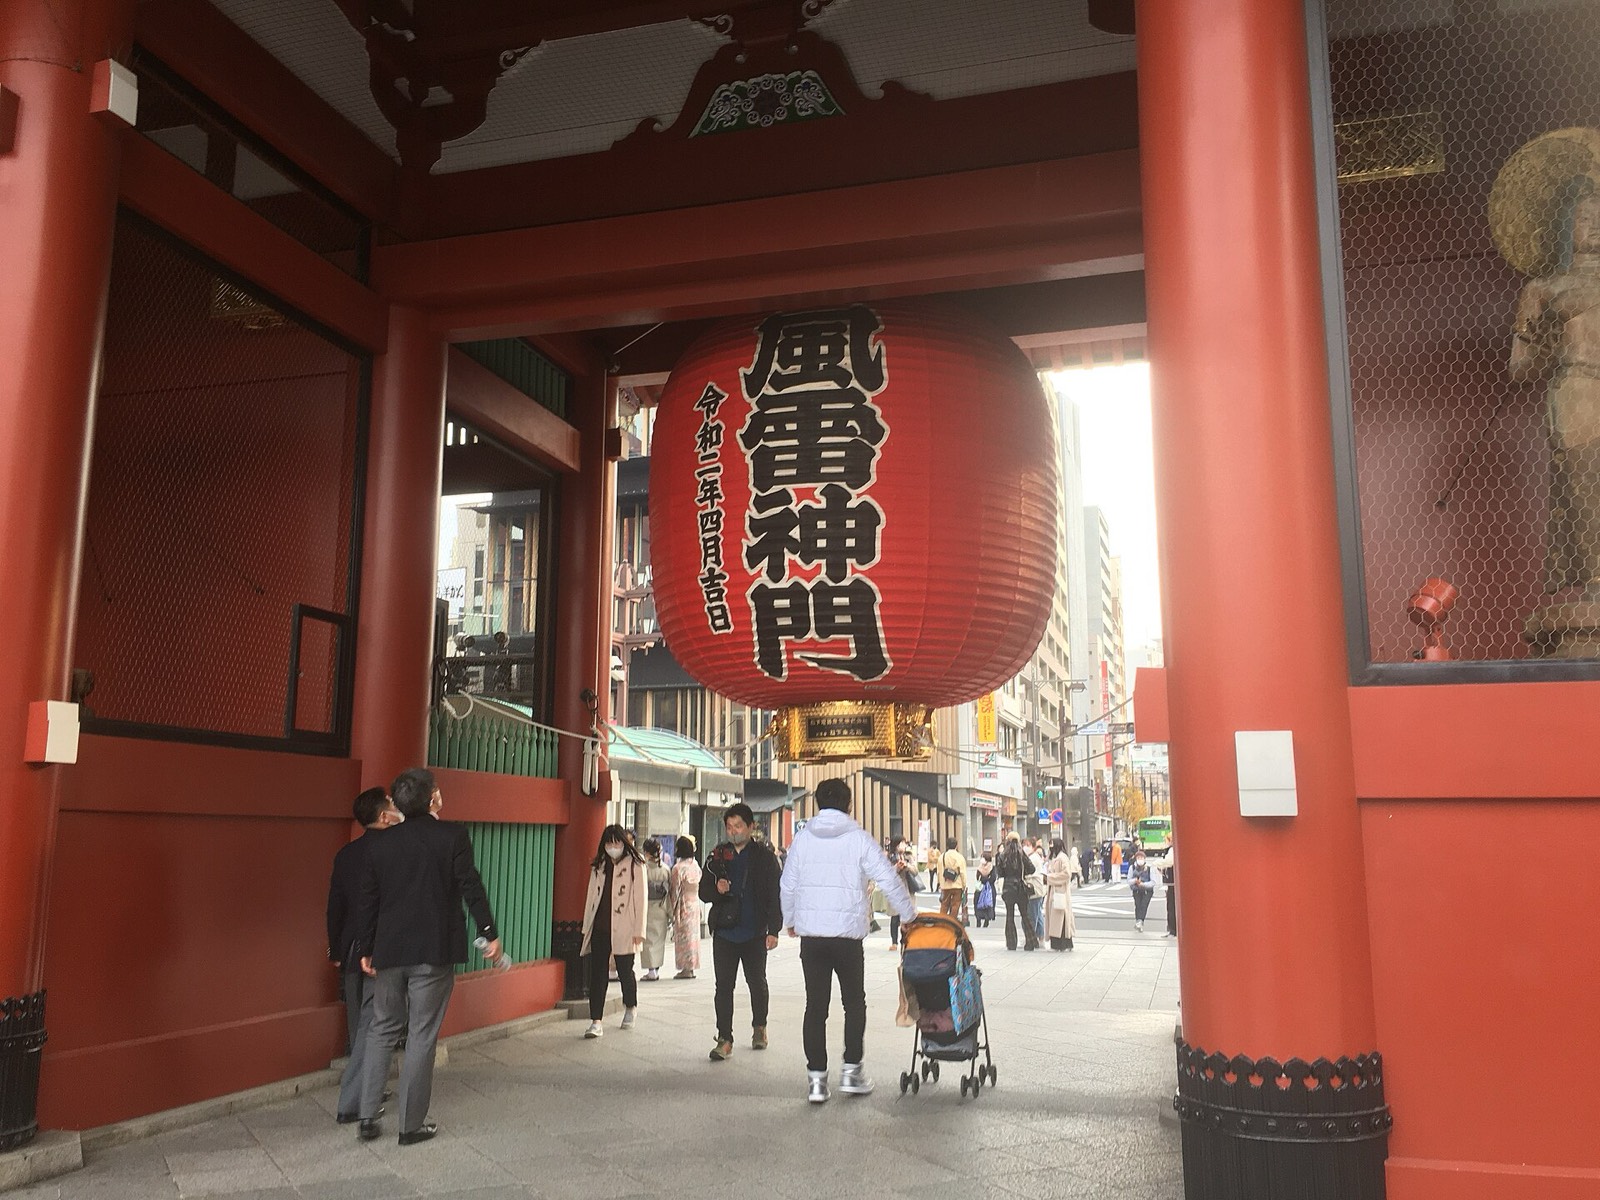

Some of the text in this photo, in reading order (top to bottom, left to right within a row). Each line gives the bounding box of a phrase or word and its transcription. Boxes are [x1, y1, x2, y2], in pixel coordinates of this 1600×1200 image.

[693, 382, 734, 634] 令和二年四月吉日
[737, 304, 893, 682] 風雷神門
